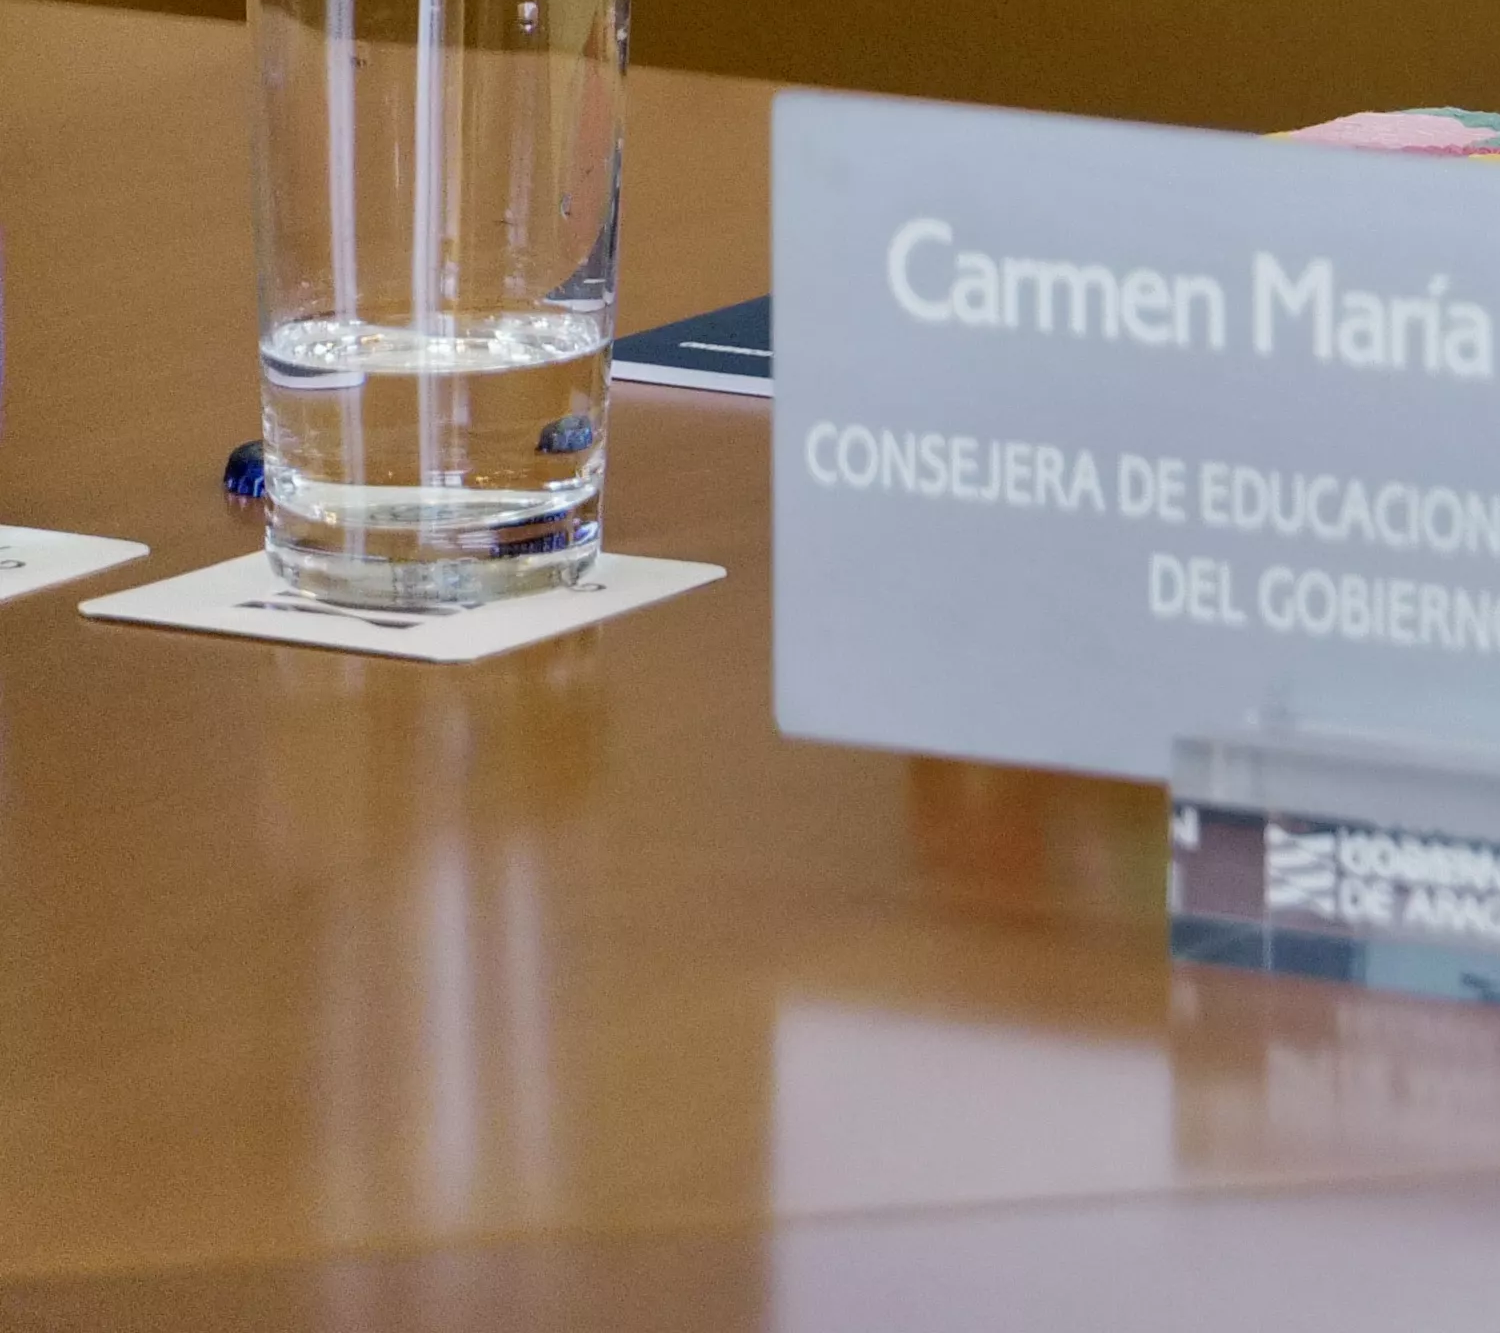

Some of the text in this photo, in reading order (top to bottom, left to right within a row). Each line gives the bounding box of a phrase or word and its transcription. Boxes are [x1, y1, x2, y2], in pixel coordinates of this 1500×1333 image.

[887, 217, 1227, 351] Carmen
[1251, 250, 1494, 379] María
[805, 421, 1106, 512] CONSEJERA
[1118, 453, 1188, 522] DE
[1148, 552, 1247, 626] DEL
[1339, 874, 1397, 926] DE
